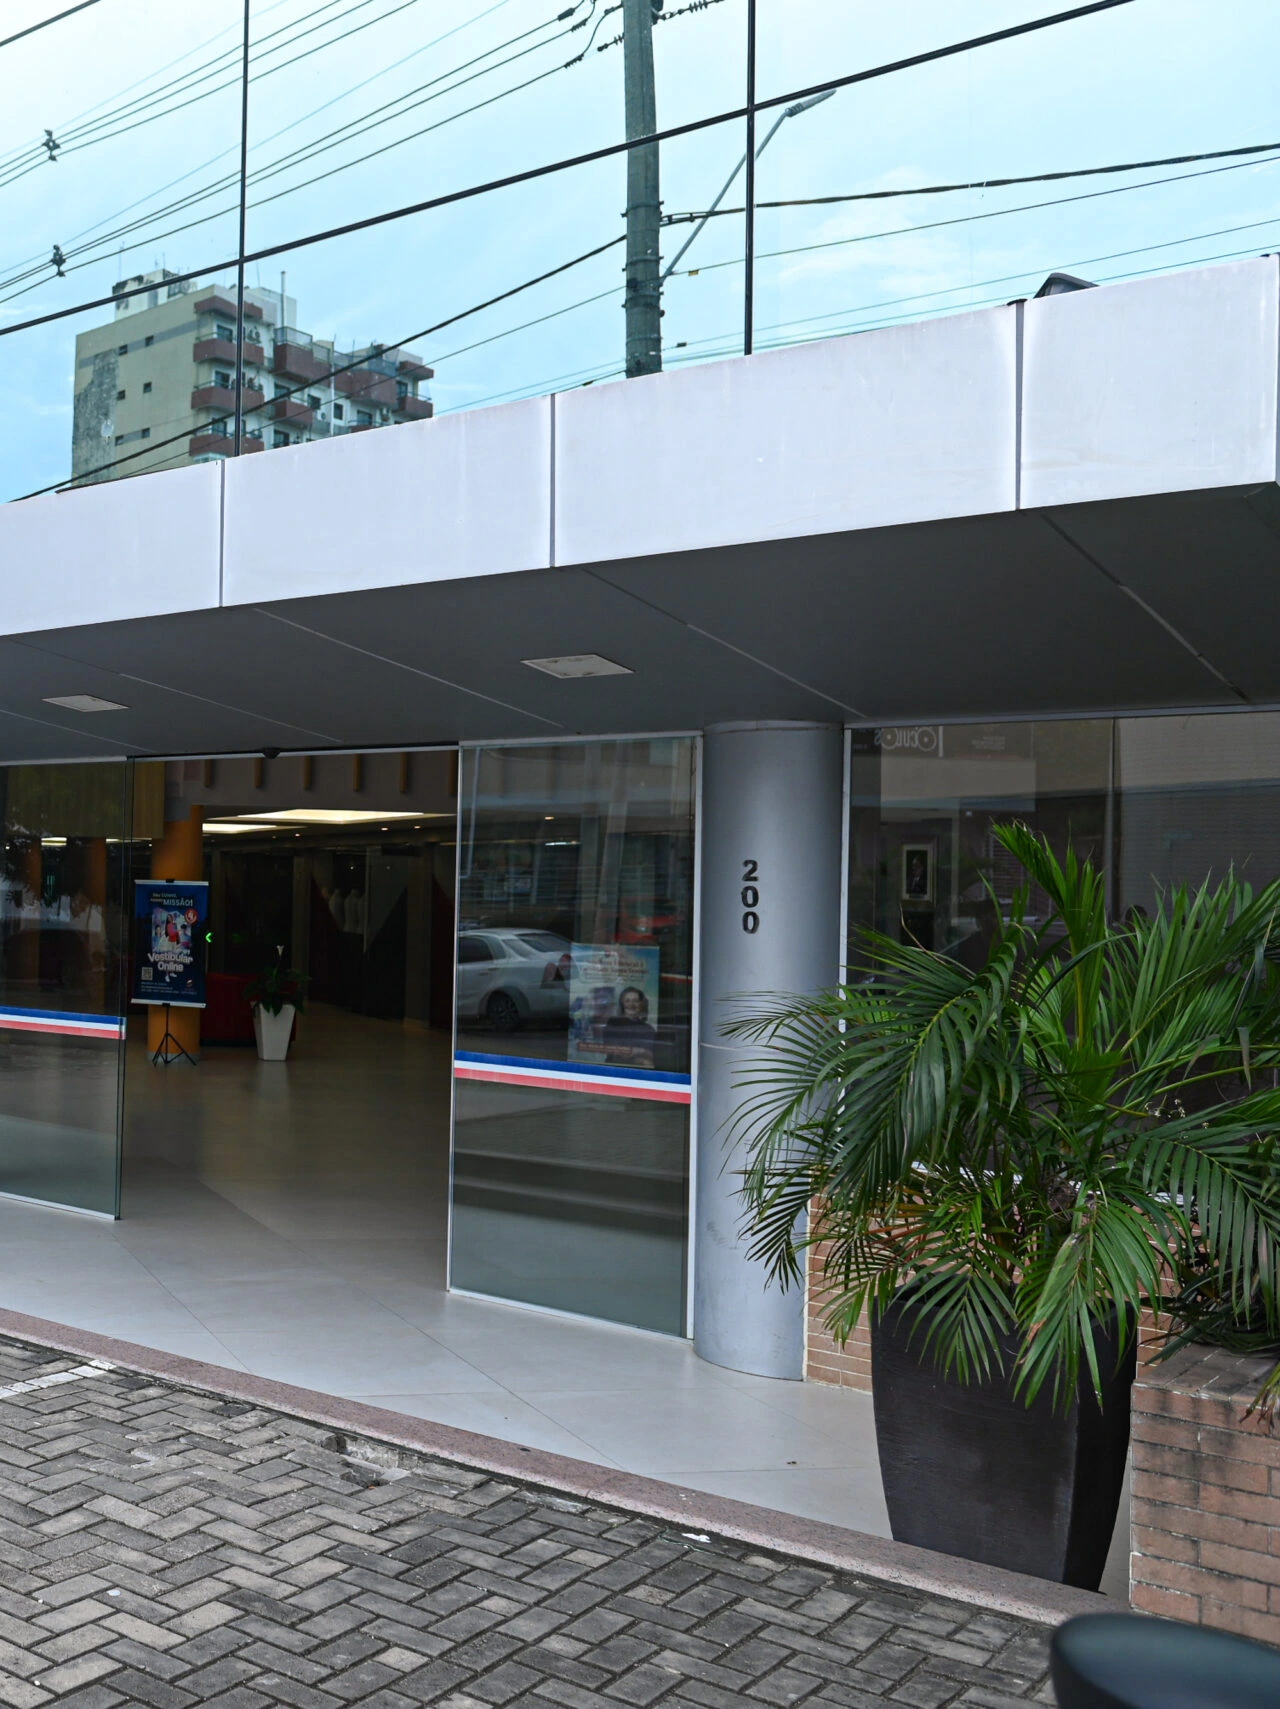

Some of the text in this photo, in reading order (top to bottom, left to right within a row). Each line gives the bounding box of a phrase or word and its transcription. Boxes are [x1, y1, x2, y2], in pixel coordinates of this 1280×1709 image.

[741, 859, 760, 934] 200
[147, 952, 194, 965] Vestibular
[157, 962, 184, 973] Online
